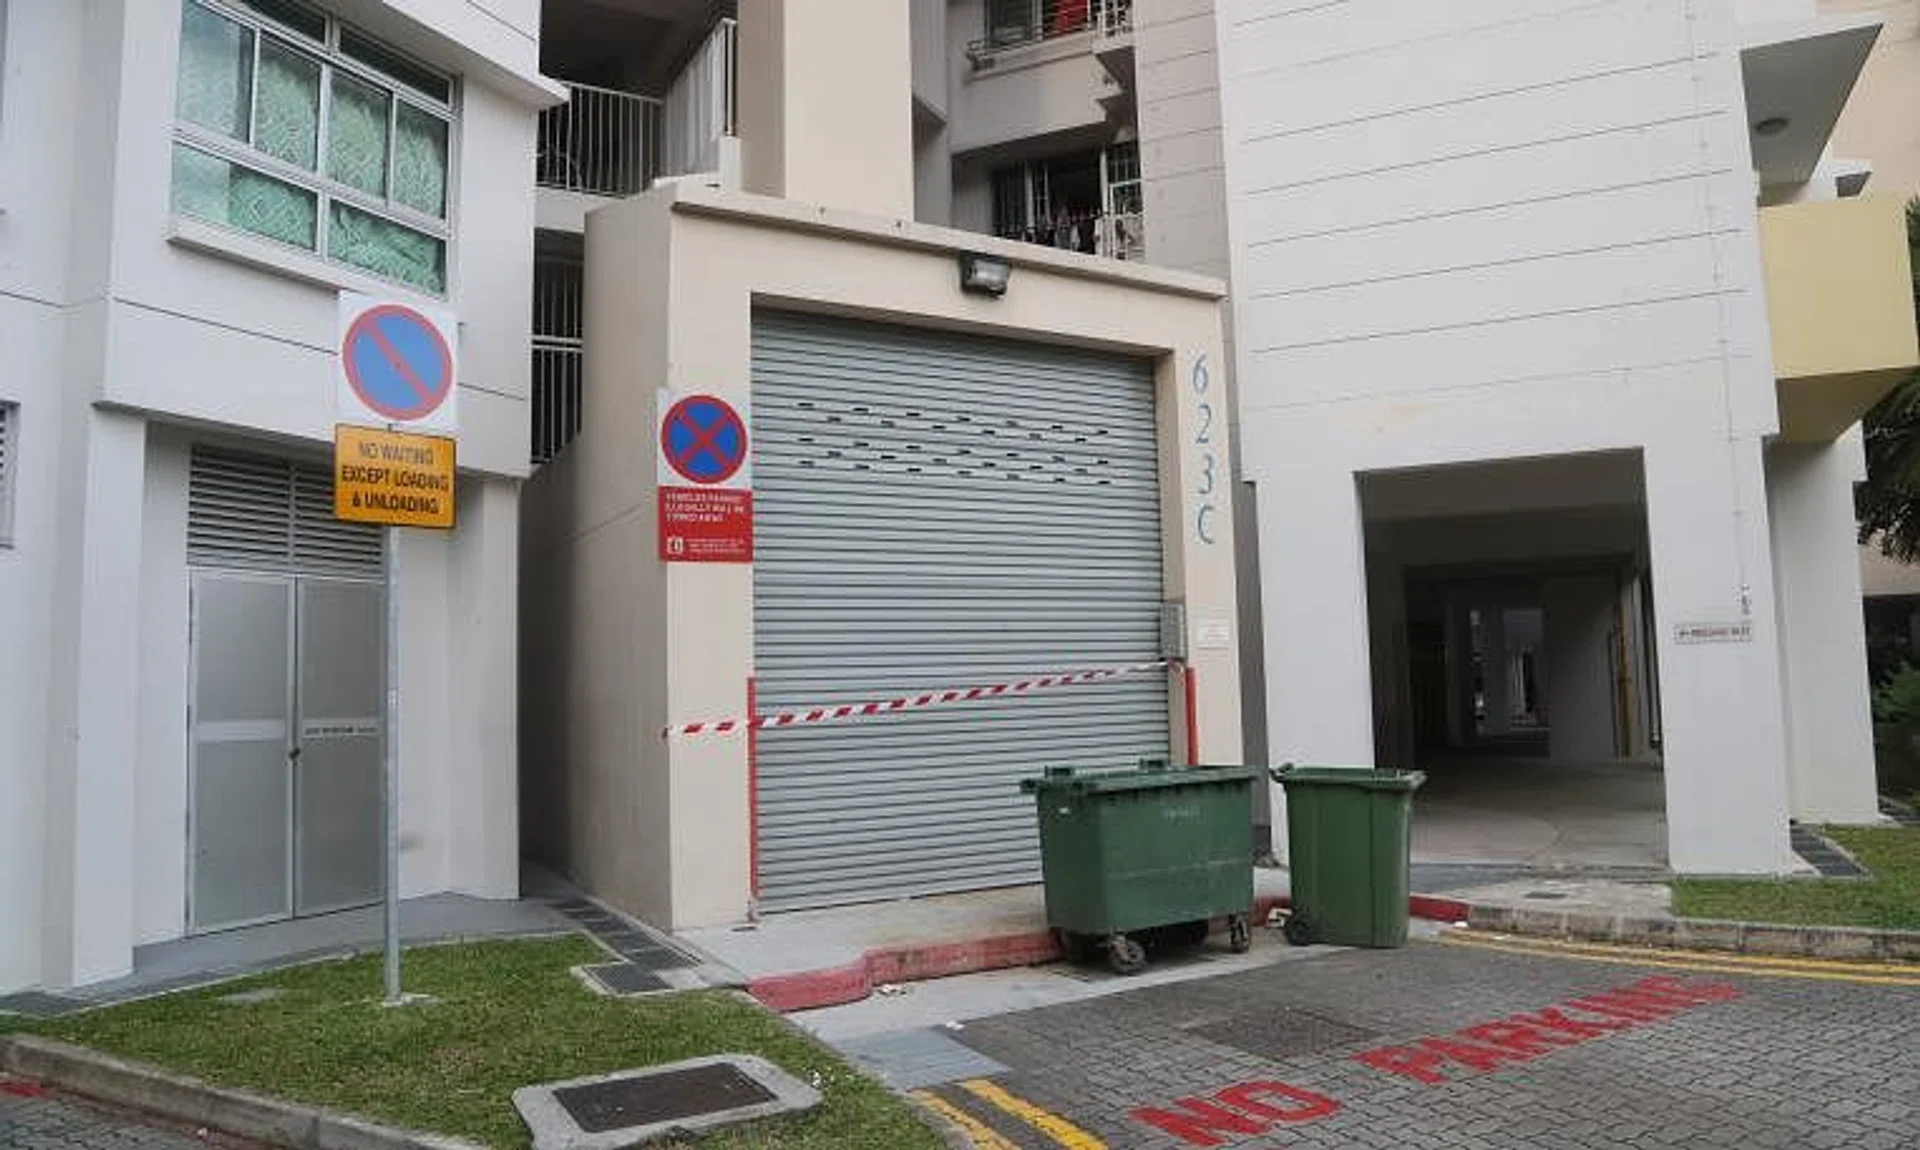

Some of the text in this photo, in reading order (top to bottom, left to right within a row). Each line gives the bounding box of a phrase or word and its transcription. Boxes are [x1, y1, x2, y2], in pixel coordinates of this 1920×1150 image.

[359, 441, 434, 465] NO WAITING
[1192, 353, 1215, 545] 623C
[342, 465, 449, 492] EXCEPT LOADING
[365, 490, 439, 514] UNLOADING
[1128, 975, 1740, 1147] NO PARKING
